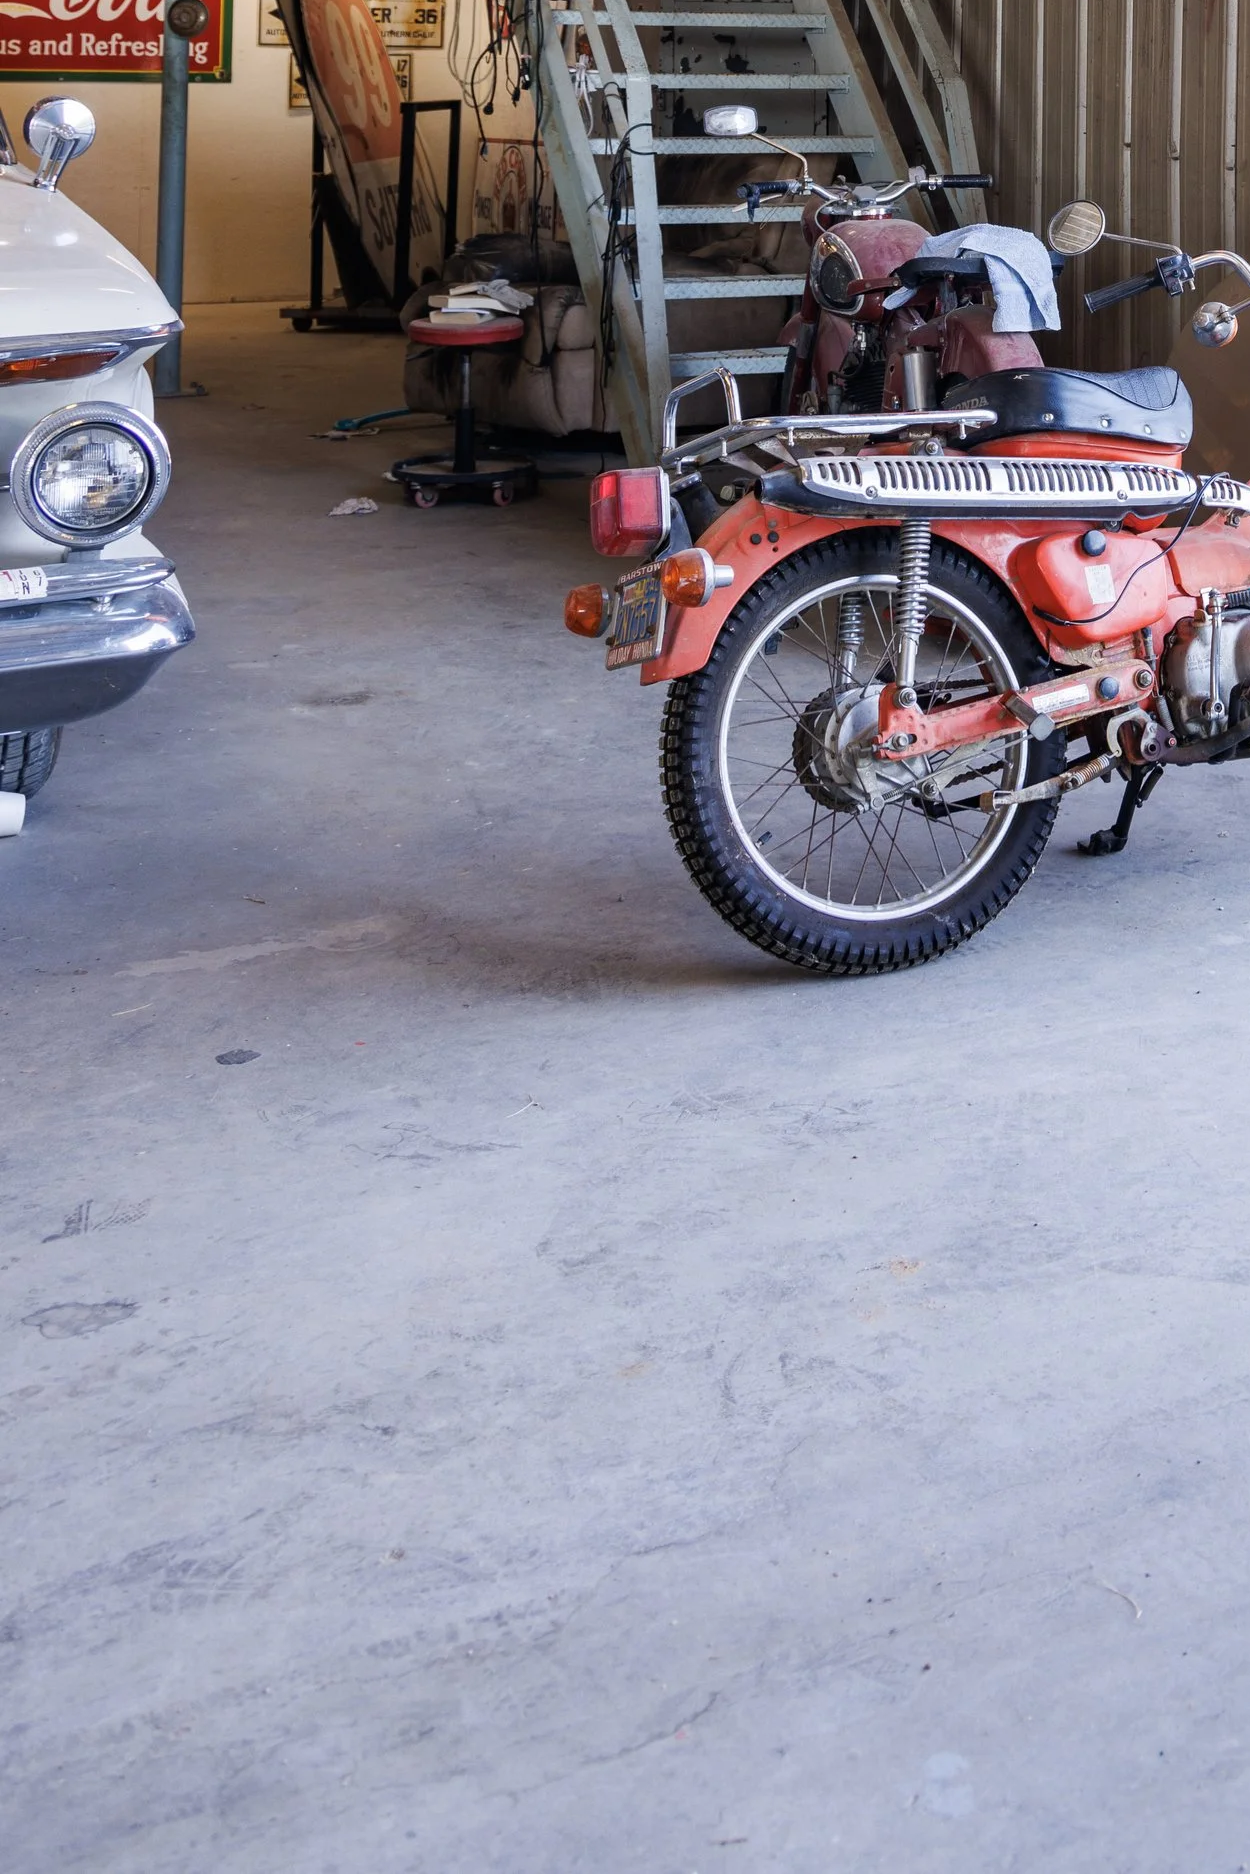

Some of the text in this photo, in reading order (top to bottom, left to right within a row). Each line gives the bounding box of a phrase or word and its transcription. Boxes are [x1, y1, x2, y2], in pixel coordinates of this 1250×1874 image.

[414, 8, 437, 24] 36
[28, 33, 73, 56] and
[80, 32, 208, 64] Refresng
[396, 59, 408, 72] 17
[950, 395, 990, 411] ONDA
[620, 561, 662, 584] BARSTOW
